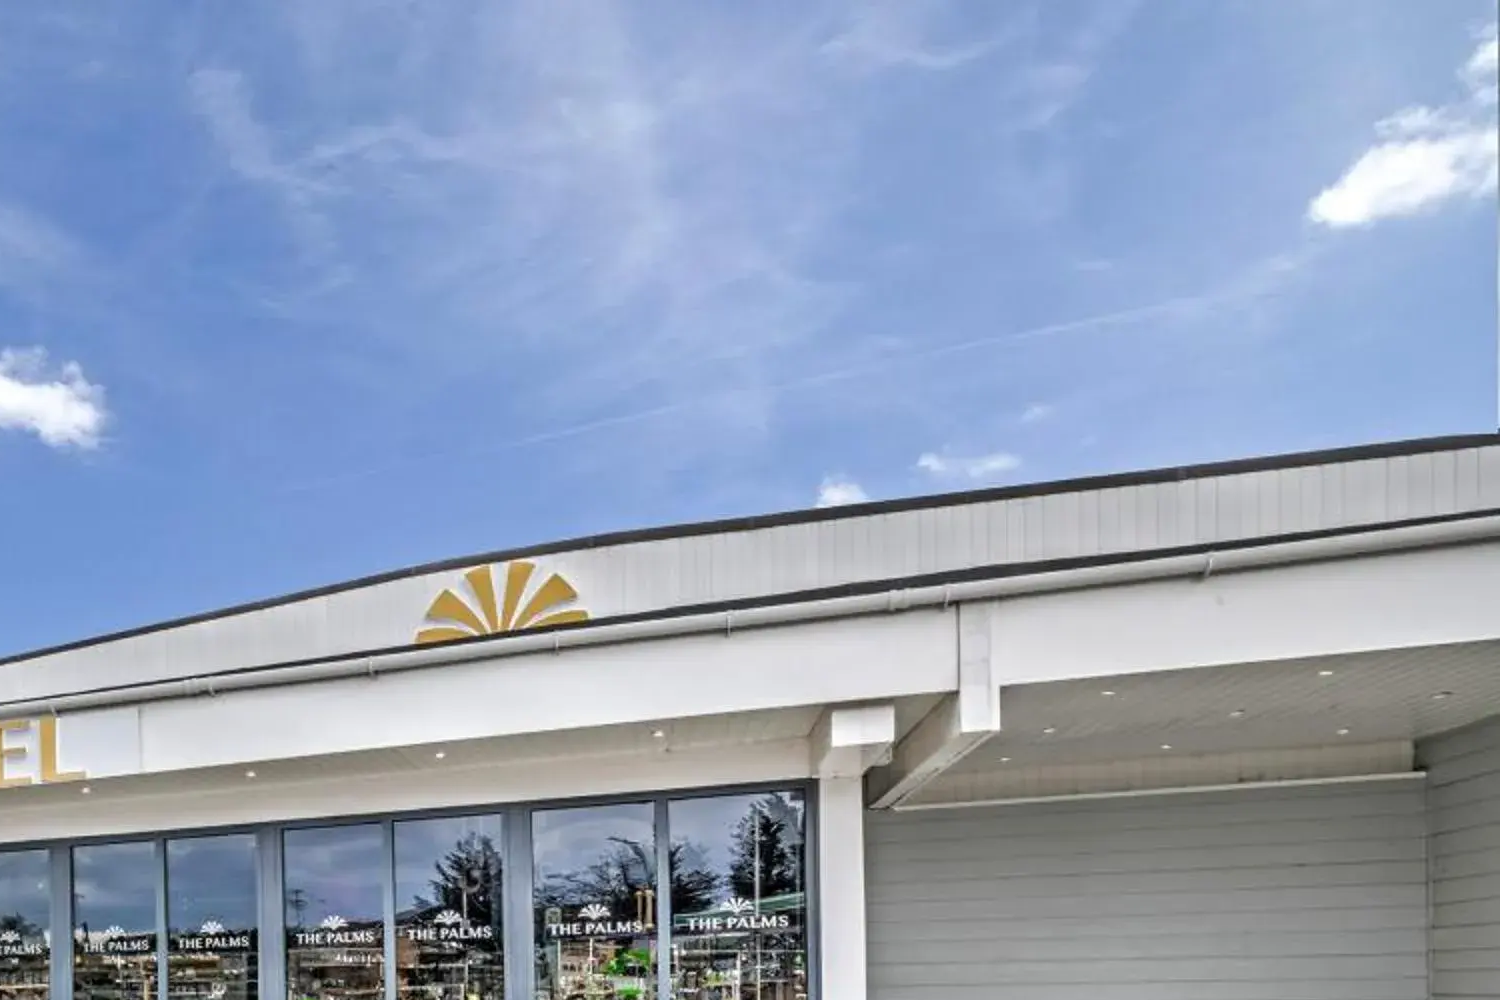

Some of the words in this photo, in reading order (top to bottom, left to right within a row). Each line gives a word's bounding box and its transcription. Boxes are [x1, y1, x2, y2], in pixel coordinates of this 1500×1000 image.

[548, 922, 581, 936] THE
[584, 919, 644, 935] PALMS
[688, 917, 723, 931] THE
[727, 914, 790, 929] PALMS
[296, 932, 323, 945] THE
[327, 930, 375, 944] PALMS
[407, 928, 436, 941] THE
[440, 925, 493, 940] PALMS
[4, 943, 43, 956] PALMS
[84, 942, 105, 953] THE
[108, 939, 149, 951] PALMS
[179, 937, 204, 949] THE
[206, 935, 250, 949] PALMS
